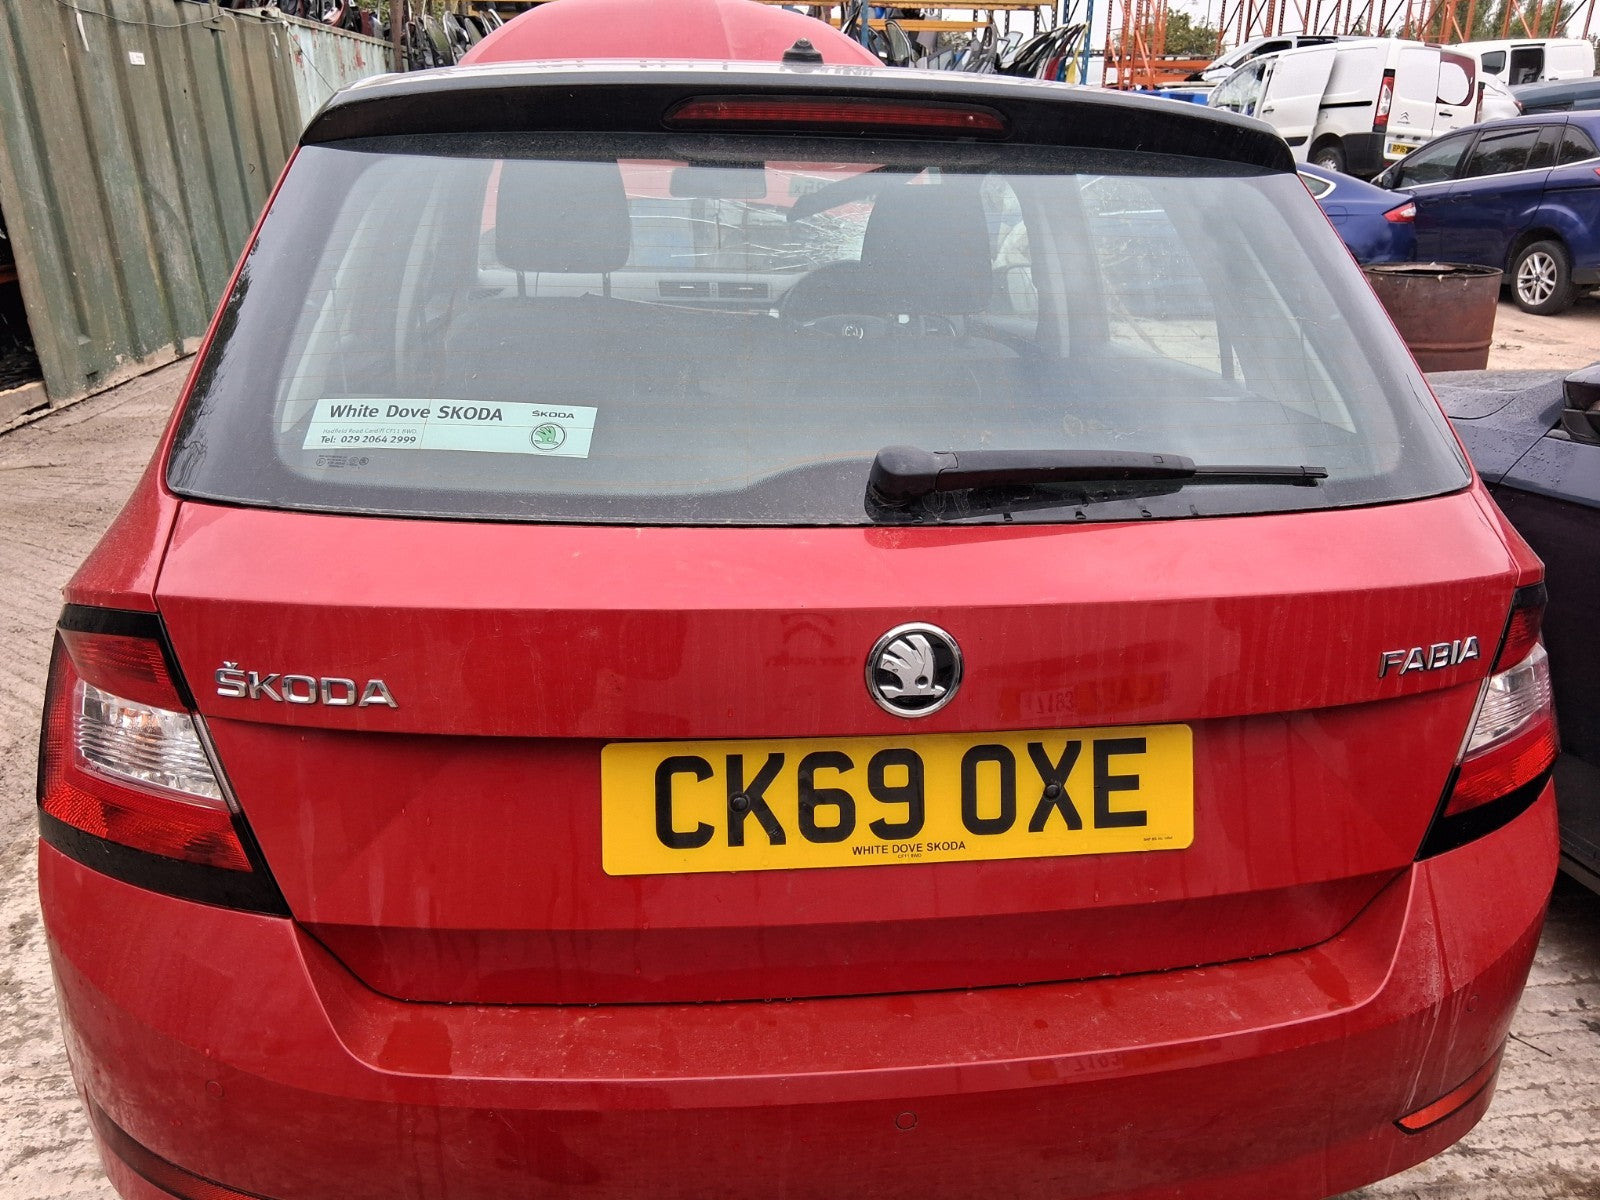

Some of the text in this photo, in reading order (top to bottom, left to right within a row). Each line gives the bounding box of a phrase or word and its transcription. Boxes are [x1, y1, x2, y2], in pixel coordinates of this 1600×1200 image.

[330, 404, 503, 421] White Dove SKODA
[321, 435, 417, 444] Tel: 029 2064 2999
[1378, 635, 1481, 678] FABIA
[215, 660, 399, 708] ŠKODA
[654, 737, 1148, 850] CK69 OXE
[852, 841, 966, 856] WHITE DOVE SKODA
